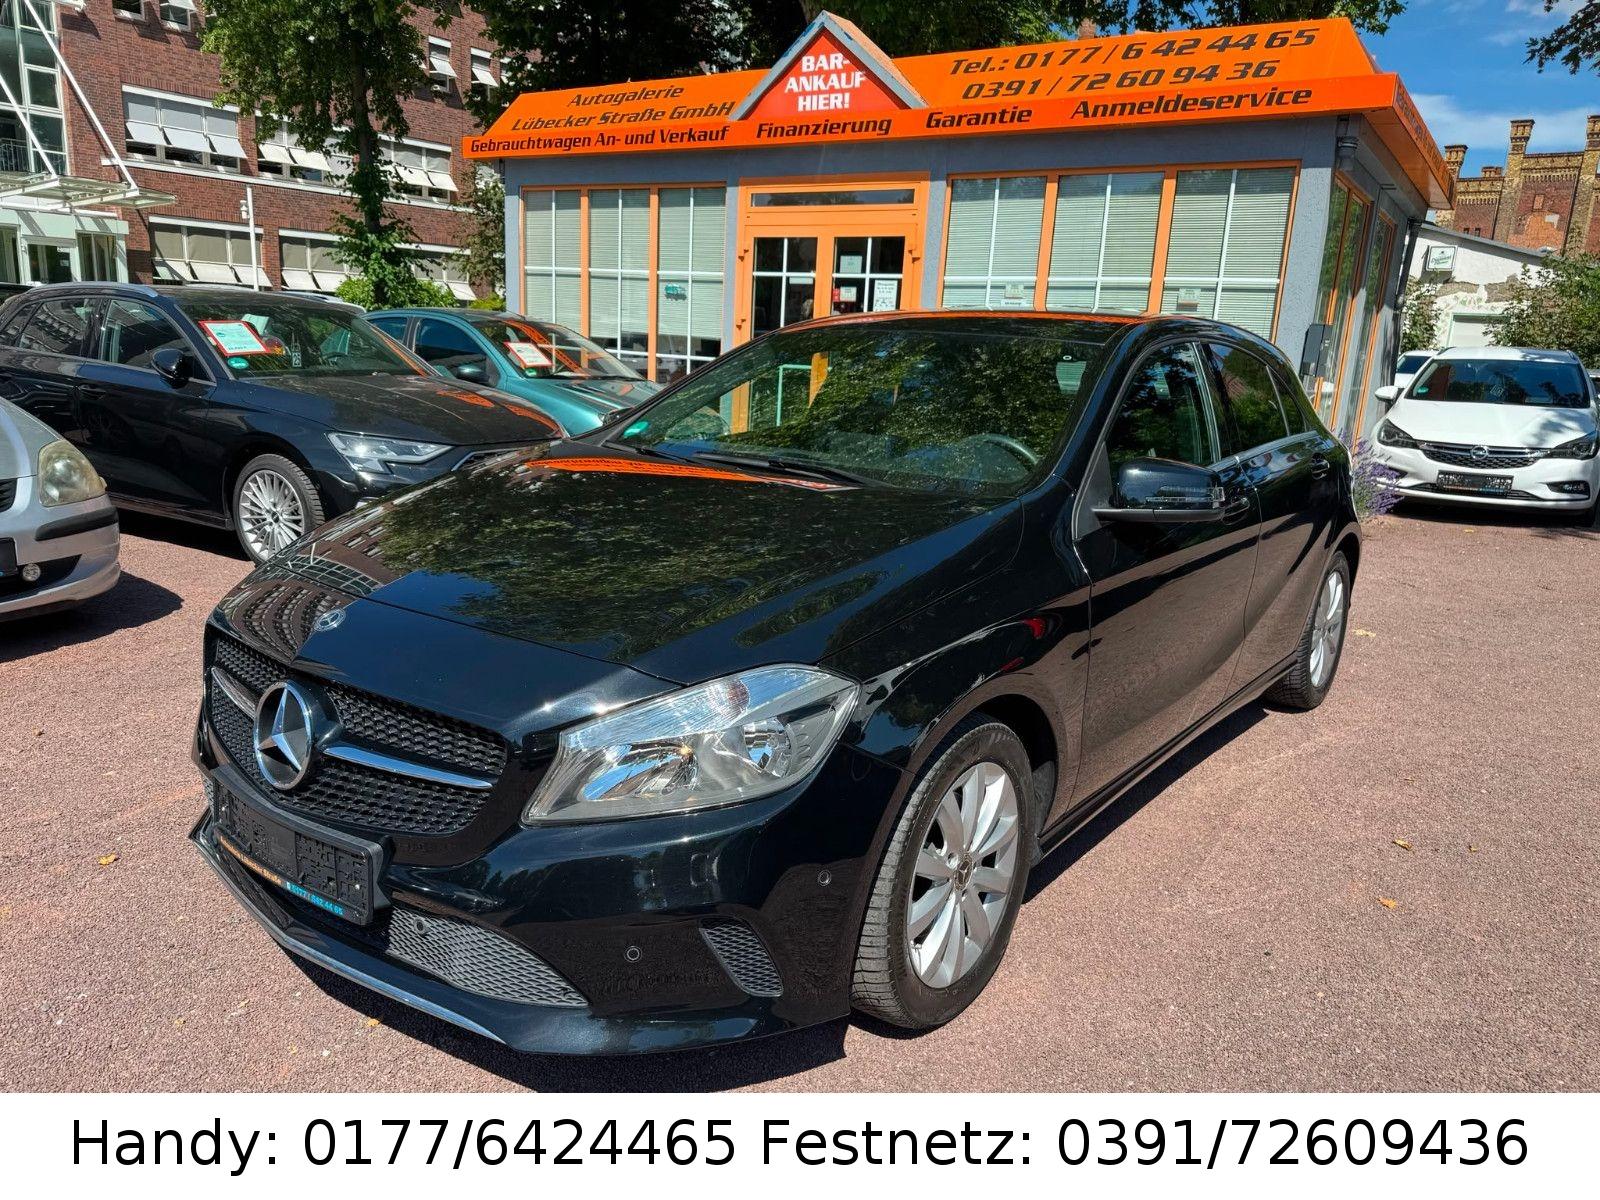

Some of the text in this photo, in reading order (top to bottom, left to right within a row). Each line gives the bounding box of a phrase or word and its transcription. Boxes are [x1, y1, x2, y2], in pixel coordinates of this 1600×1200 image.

[801, 52, 850, 72] BAR-
[950, 56, 1009, 75] Tel.:
[784, 70, 866, 93] ANKAUF
[962, 78, 1042, 100] 0391
[1067, 73, 1111, 92] 72
[1116, 69, 1165, 88] 60
[1169, 64, 1220, 84] 94
[1226, 59, 1280, 81] 36
[567, 84, 684, 107] Autogalerie
[797, 92, 850, 112] HIER!
[1070, 87, 1313, 119] Anmeldeservice
[511, 100, 736, 131] Lübecker Straße GmbH
[925, 105, 1033, 129] Garantie
[471, 126, 730, 152] Gebrauchtwagen An- und Verkauf
[756, 118, 892, 138] Finanzierung
